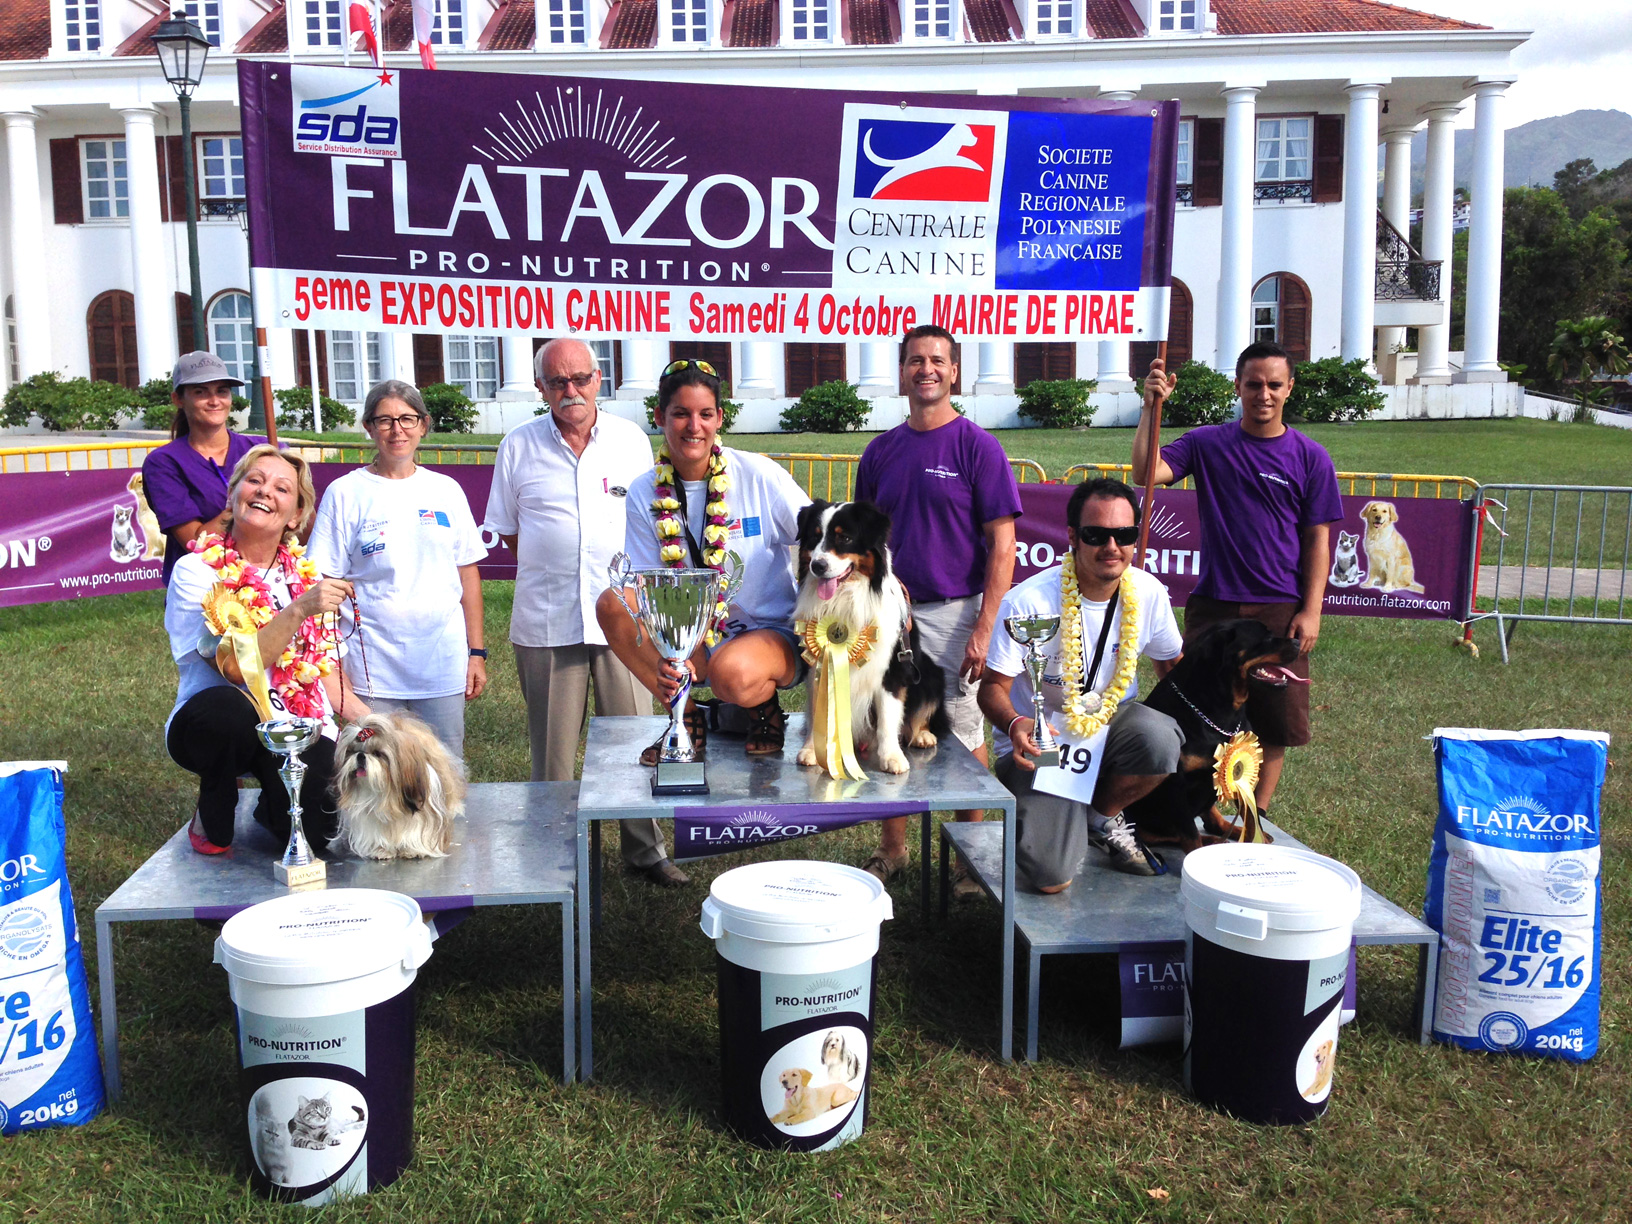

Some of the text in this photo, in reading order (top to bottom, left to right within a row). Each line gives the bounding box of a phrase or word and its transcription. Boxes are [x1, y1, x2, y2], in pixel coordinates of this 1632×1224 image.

[296, 104, 398, 145] sda
[298, 142, 397, 156] Service Distribution Assurance
[1038, 145, 1112, 164] SOCIETE
[1040, 170, 1108, 189] CANINE
[331, 157, 834, 250] FLATAZOR
[1019, 193, 1125, 211] REGIONALE
[848, 208, 986, 239] CENTRALE
[1020, 217, 1121, 235] POLYNESIE
[1017, 241, 1122, 261] FRANÇAISE
[846, 246, 986, 277] CANINE
[295, 276, 1134, 335] 5eme EXPOSITION CANINE Samedi 4 Octobre MAIRIE DE PIRAE
[361, 543, 385, 556] sda
[60, 567, 164, 589] www.pro-nutrition.
[1322, 594, 1451, 611] -nutrition.flatazor.com
[1457, 805, 1596, 834] FLATAZOR
[690, 825, 821, 841] FLATAZOR
[0, 924, 52, 940] RGANOLYSATS
[1441, 850, 1474, 1028] PROFESSIONNEL
[1480, 915, 1562, 954] Elite
[1478, 951, 1586, 989] 25/16
[807, 1005, 838, 1014] FLATAZOR
[1569, 1027, 1583, 1036] net
[1535, 1034, 1584, 1052] 20kg
[275, 1053, 311, 1061] FLATAZOR
[58, 1087, 76, 1102] net
[20, 1098, 78, 1125] 20kg
